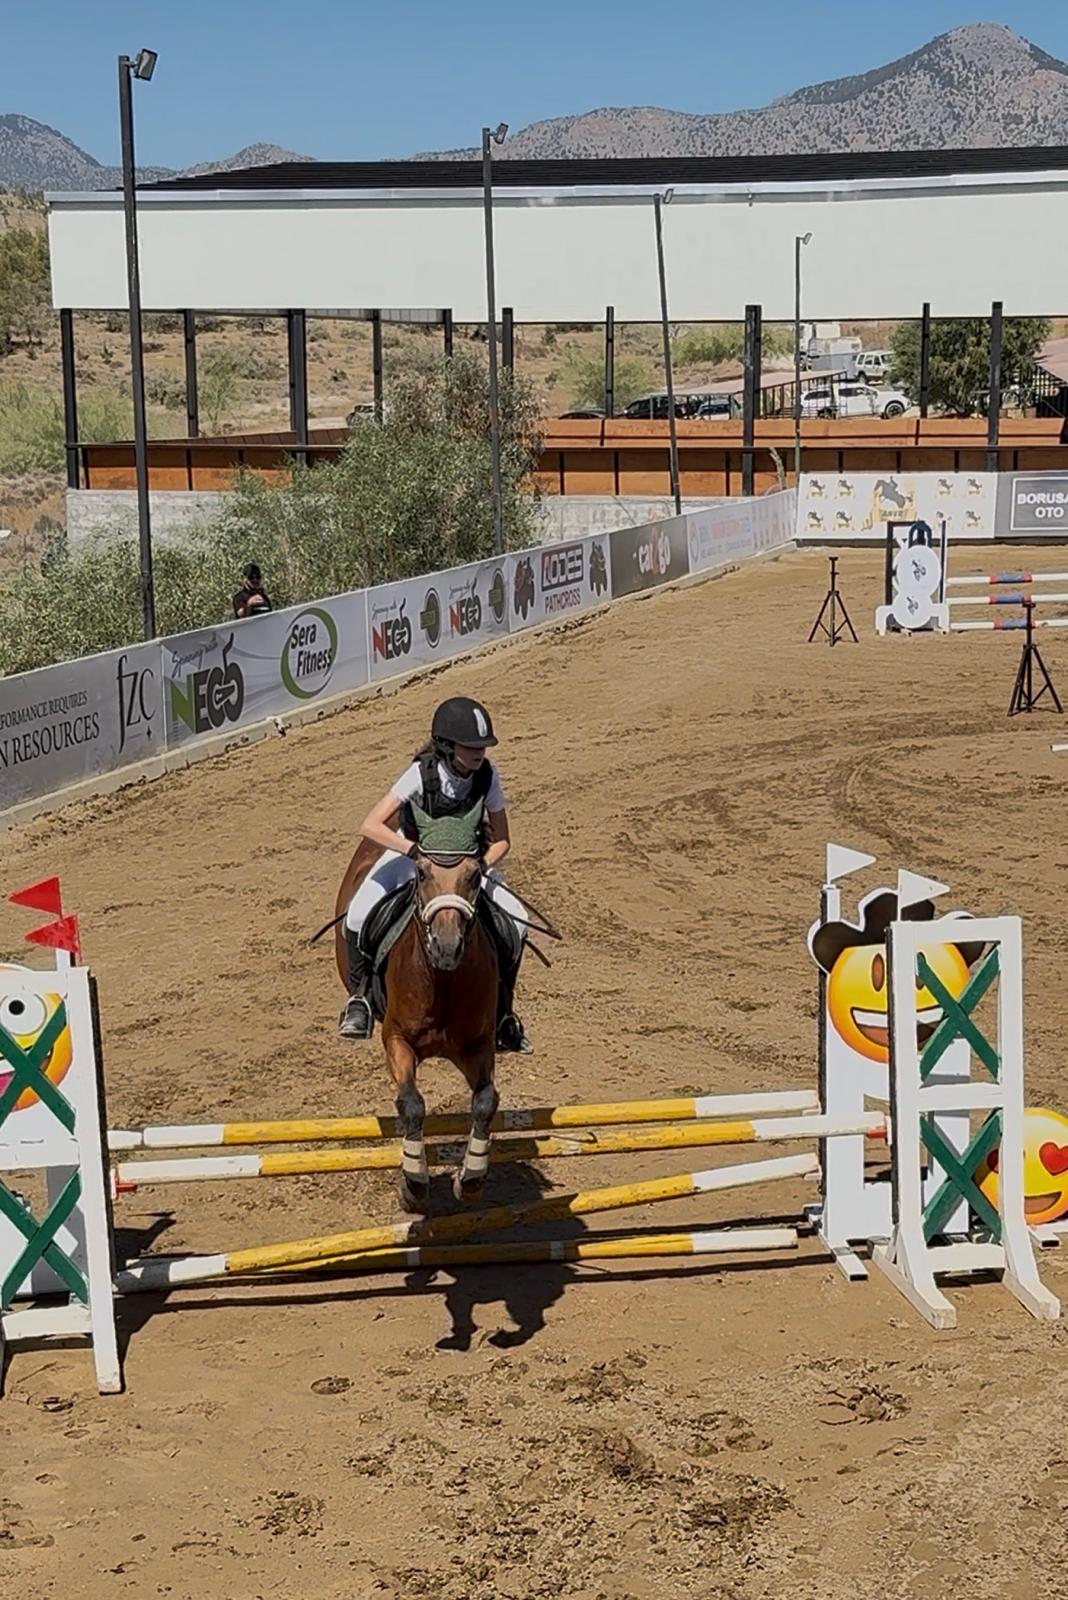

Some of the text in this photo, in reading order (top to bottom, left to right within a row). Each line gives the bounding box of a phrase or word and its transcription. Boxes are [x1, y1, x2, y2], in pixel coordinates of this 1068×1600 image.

[1035, 506, 1064, 518] OTO
[449, 577, 482, 637] NEGO
[291, 623, 317, 650] Sera
[372, 598, 412, 661] NEGO
[296, 647, 333, 677] Fitness
[49, 690, 88, 715] REQUIRES
[170, 632, 245, 735] NEGO
[12, 712, 100, 765] RESOURCES
